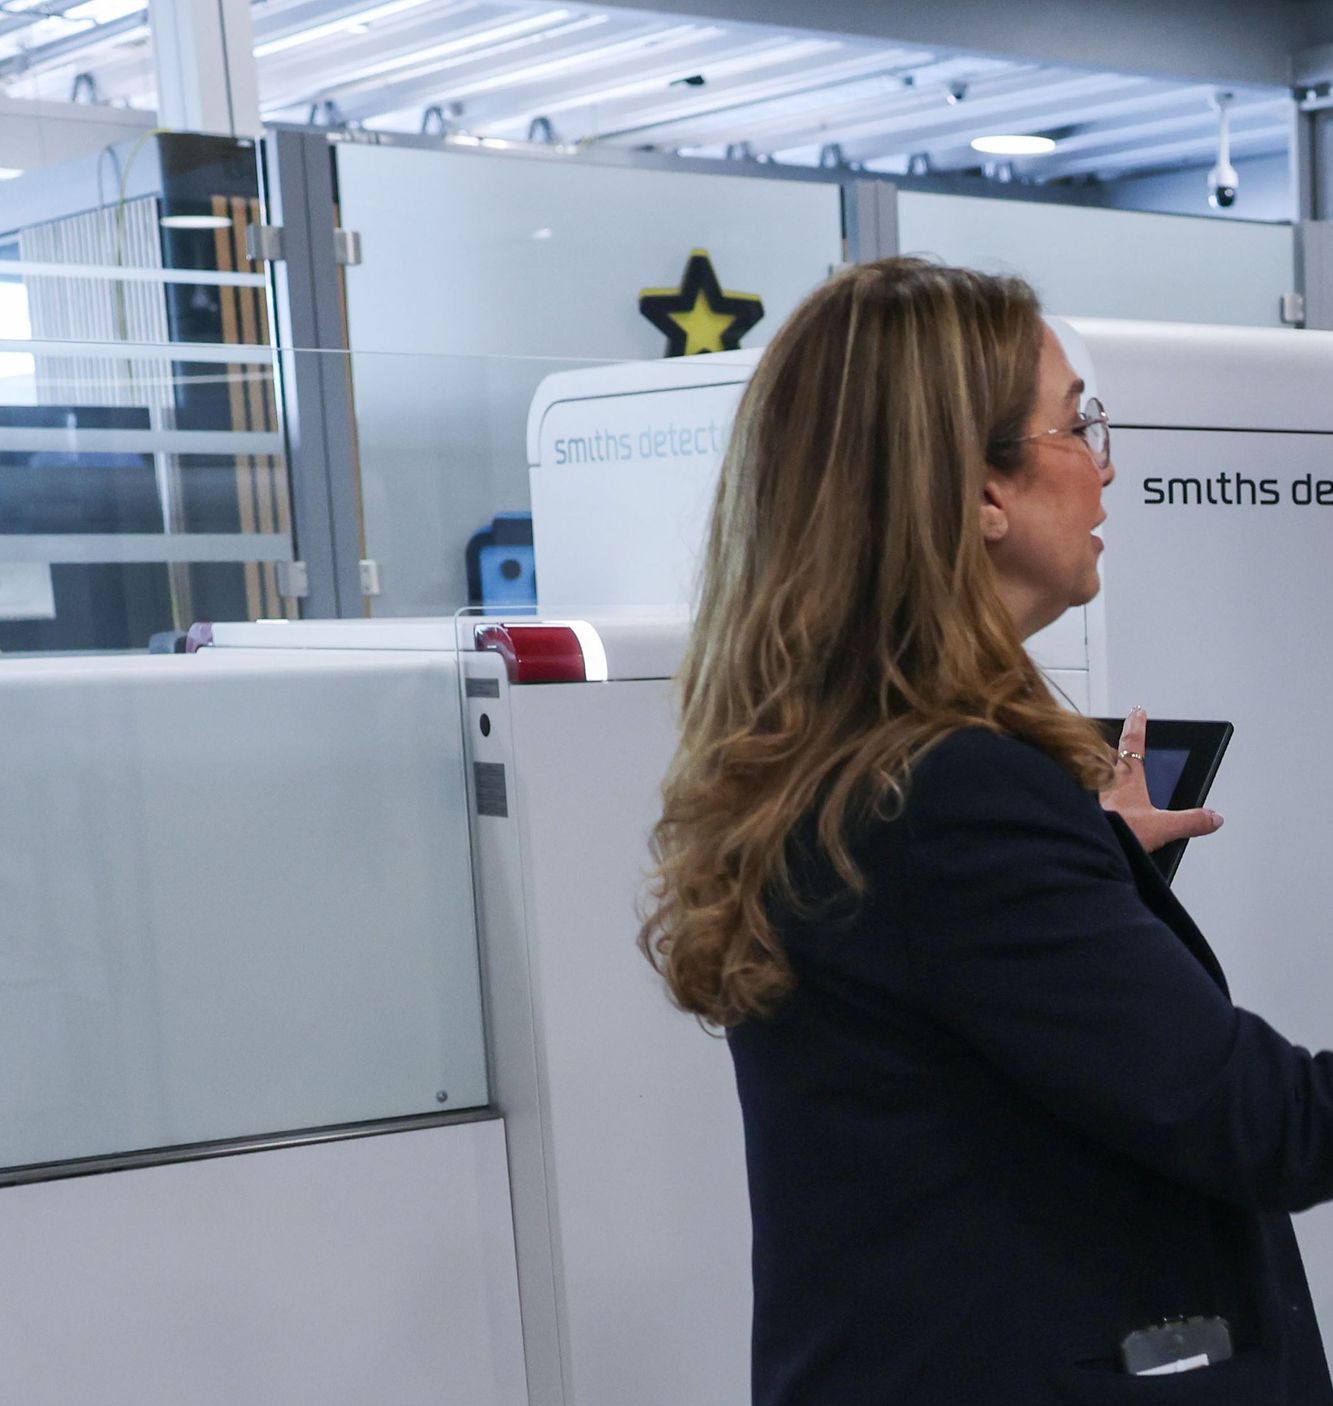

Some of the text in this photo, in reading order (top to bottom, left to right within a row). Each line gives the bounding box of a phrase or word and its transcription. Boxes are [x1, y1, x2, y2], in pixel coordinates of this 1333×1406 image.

[554, 419, 727, 465] smiths detect
[1143, 472, 1281, 505] smiths
